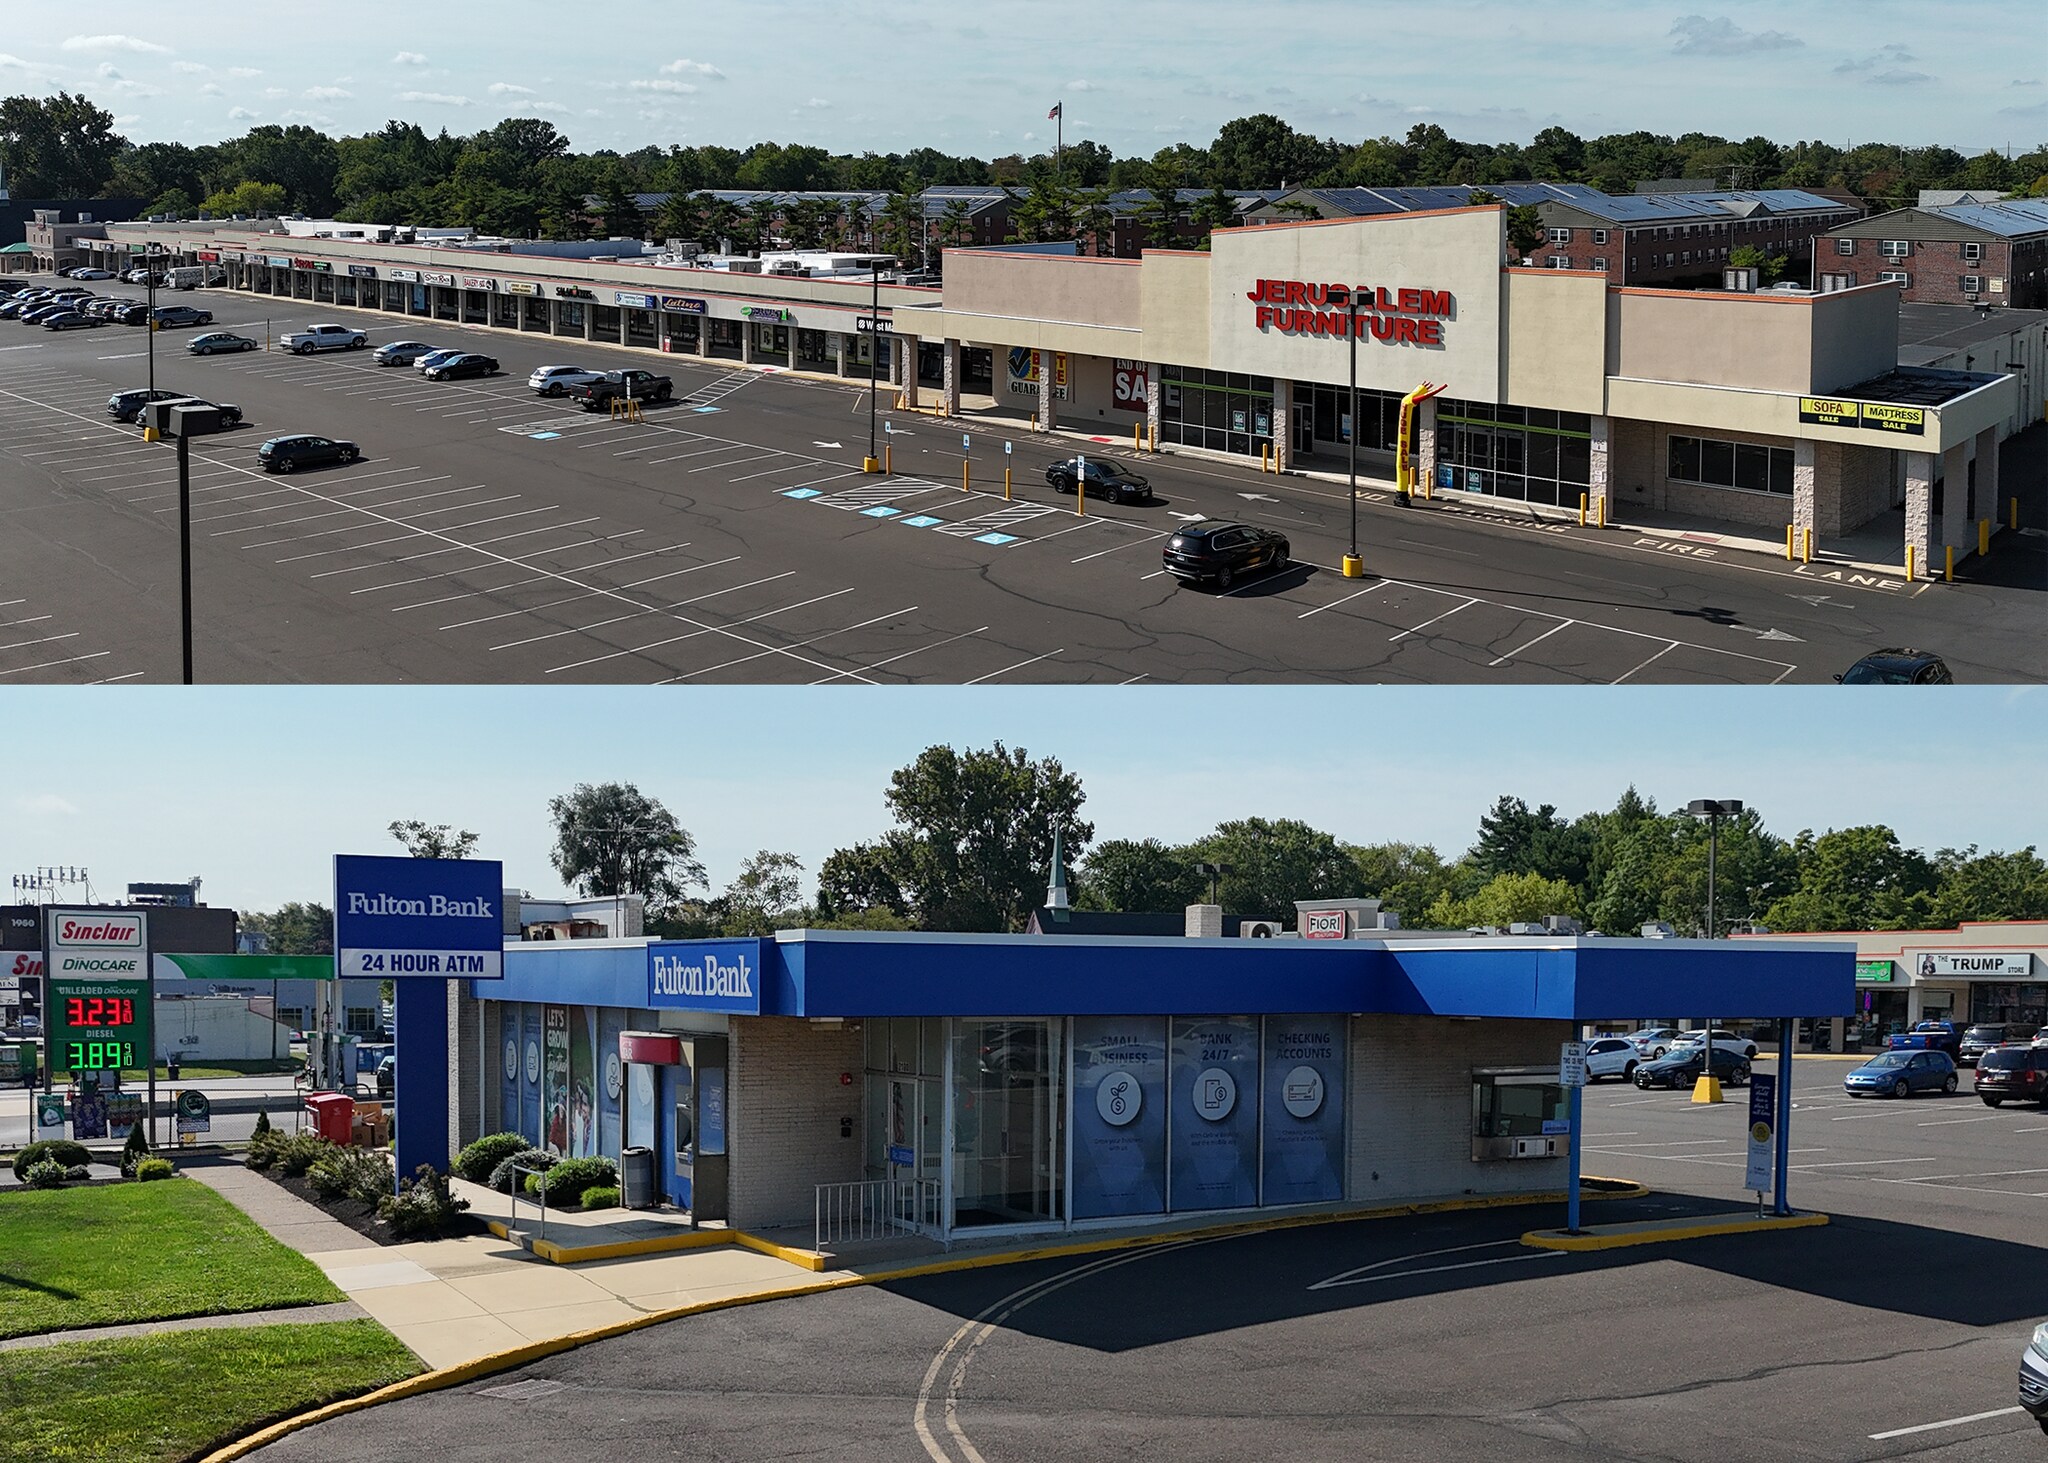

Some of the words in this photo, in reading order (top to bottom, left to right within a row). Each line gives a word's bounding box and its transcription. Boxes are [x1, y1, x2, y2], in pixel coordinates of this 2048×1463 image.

[866, 320, 884, 331] Wst
[1255, 306, 1440, 344] FURNITURE
[1116, 359, 1133, 371] END
[1136, 361, 1147, 373] OF
[1813, 401, 1844, 414] SOFA
[1869, 407, 1920, 421] MATTRESS
[1818, 415, 1839, 423] SALE
[1882, 421, 1907, 431] SALE
[1633, 538, 1718, 559] FIRE
[1792, 565, 1906, 591] LANE
[347, 892, 428, 916] Fulton
[429, 894, 493, 918] Bank
[1310, 917, 1340, 930] FIORI
[62, 921, 136, 940] Sinclair
[62, 958, 138, 971] DINOCARE
[361, 954, 385, 972] 24
[390, 954, 440, 972] HOUR
[445, 955, 484, 973] ATM
[1951, 958, 2004, 970] TRUMP
[2007, 966, 2025, 974] STORE
[653, 956, 704, 996] Fulton
[704, 954, 753, 998] Bank
[59, 986, 103, 995] UNLEADED
[68, 998, 121, 1027] 3.23
[547, 1009, 565, 1027] LET'S
[86, 1029, 115, 1038] DIESEL
[547, 1030, 568, 1049] GROW
[1200, 1032, 1233, 1045] BANK
[1277, 1031, 1331, 1045] CHECKING
[1100, 1035, 1140, 1048] SMALL
[69, 1042, 121, 1069] 3.89
[1091, 1051, 1149, 1065] BUSINESS
[1202, 1049, 1230, 1062] 24/7
[1275, 1047, 1332, 1060] ACCOUNTS
